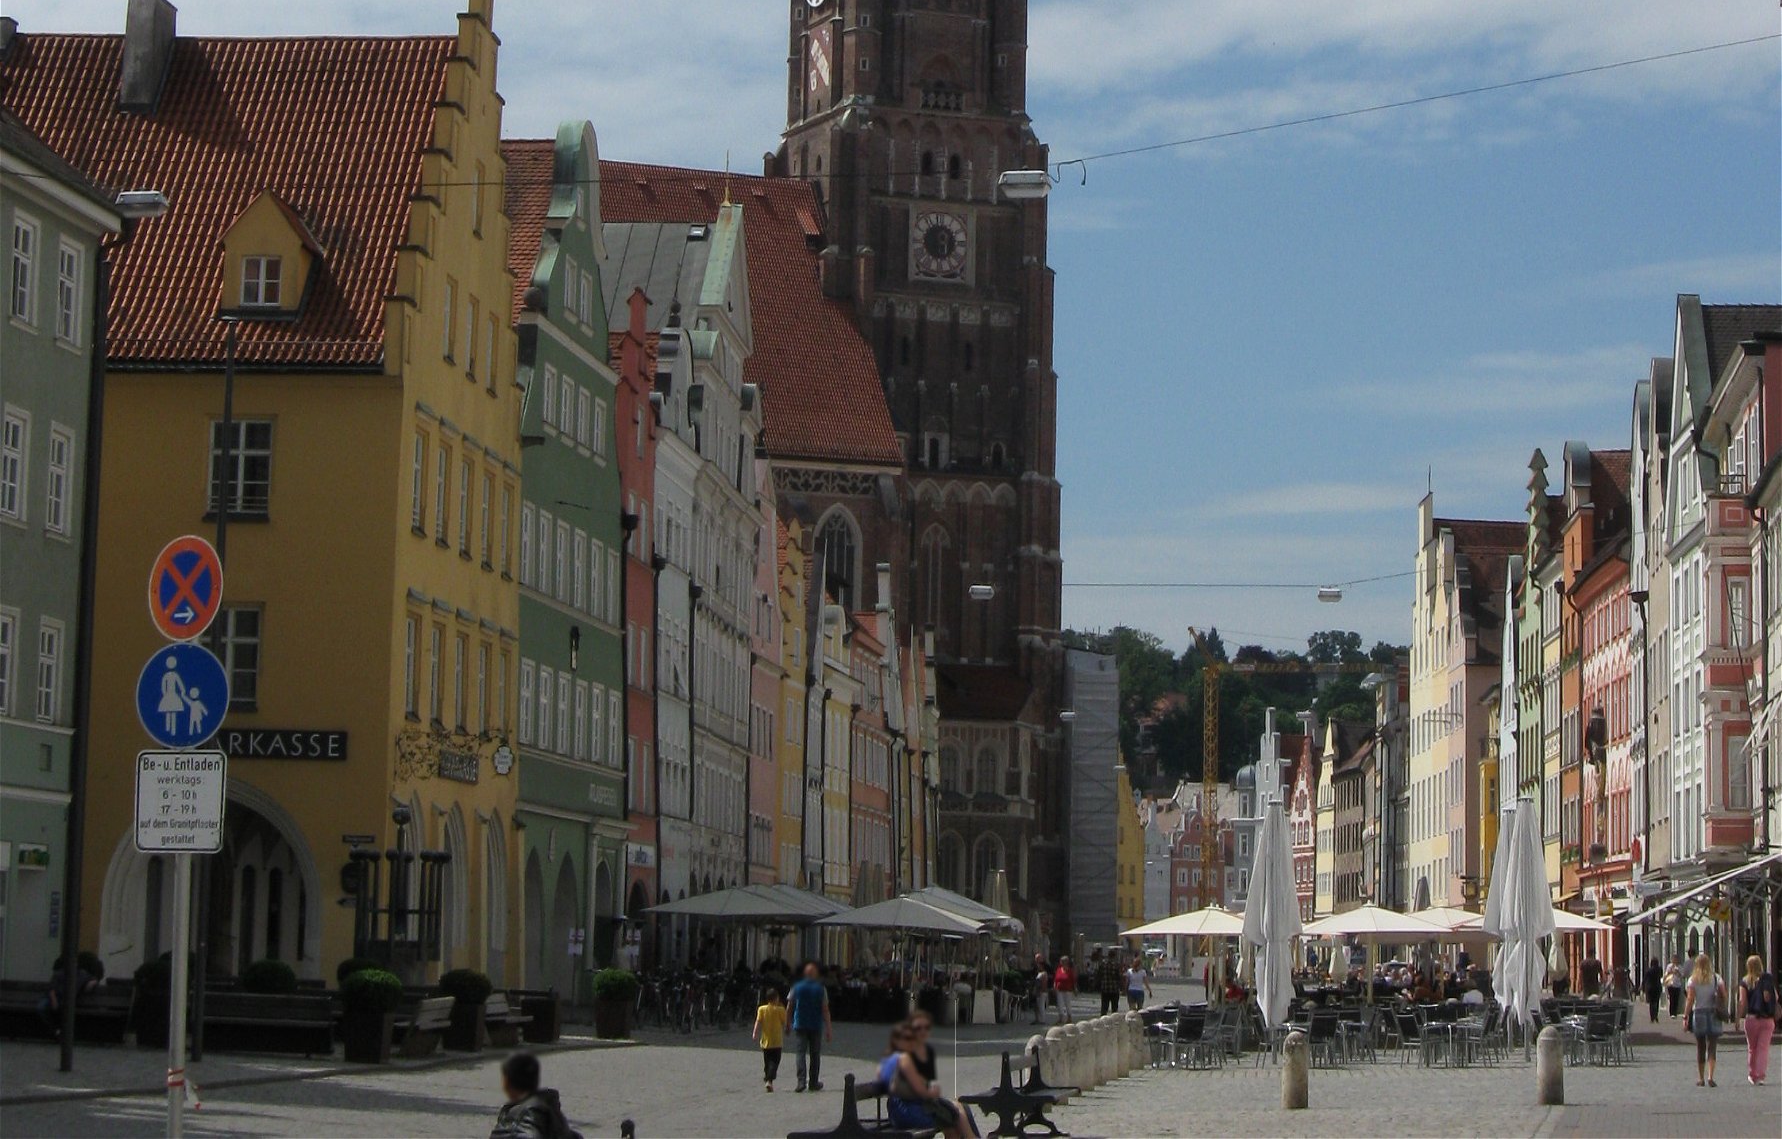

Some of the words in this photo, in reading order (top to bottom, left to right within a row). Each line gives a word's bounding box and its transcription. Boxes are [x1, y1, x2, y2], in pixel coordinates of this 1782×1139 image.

[174, 757, 220, 771] Entladen
[162, 790, 169, 799] 6
[161, 805, 171, 814] 17
[153, 819, 168, 828] dem
[161, 835, 195, 846] gestattet
